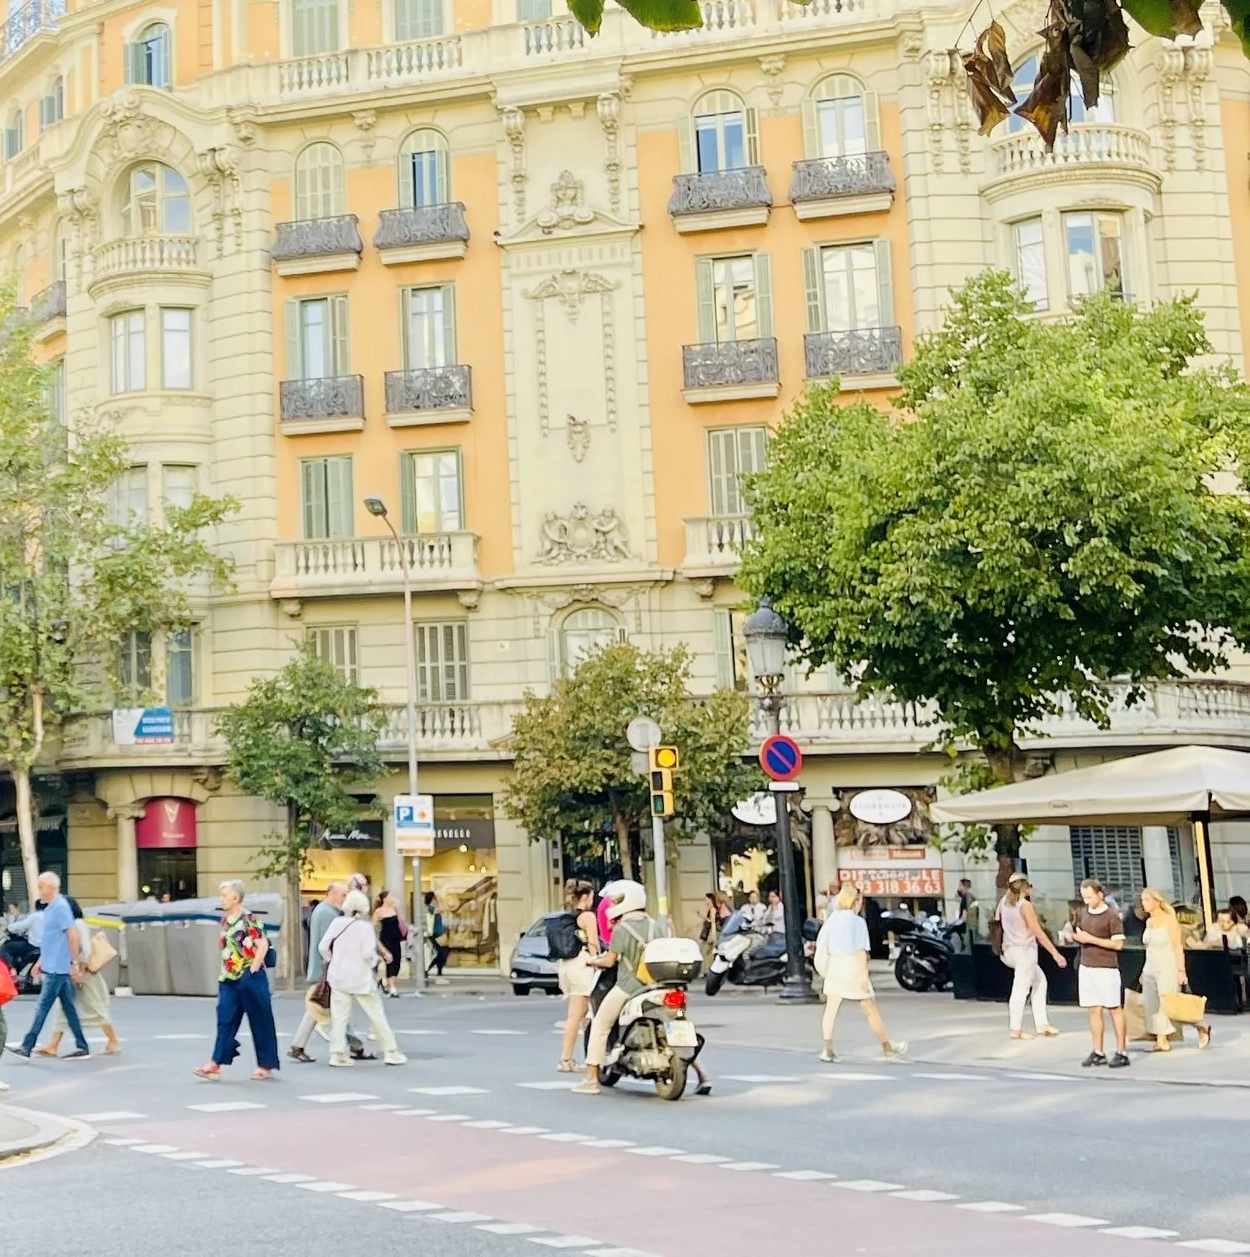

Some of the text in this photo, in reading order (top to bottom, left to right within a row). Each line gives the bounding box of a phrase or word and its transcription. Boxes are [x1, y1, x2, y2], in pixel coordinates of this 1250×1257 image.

[877, 880, 900, 894] 318
[904, 880, 920, 894] 36
[925, 880, 941, 894] 63
